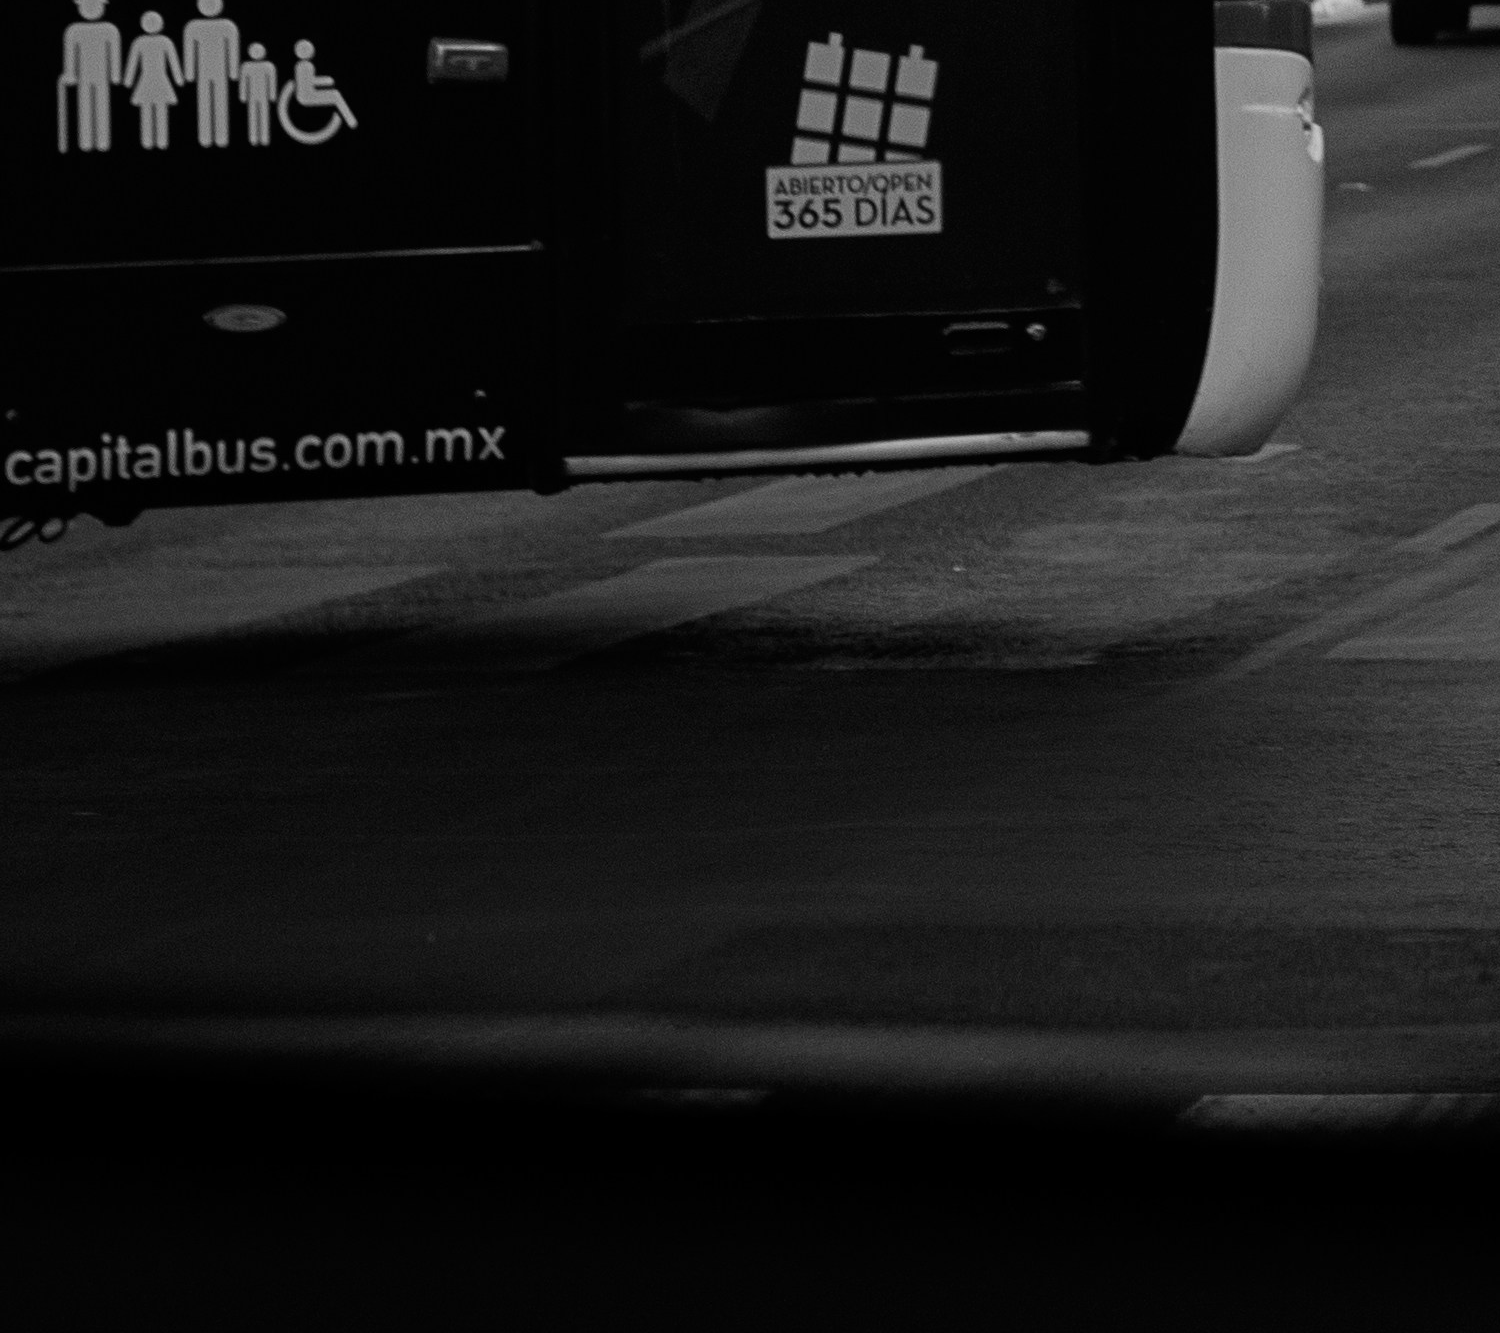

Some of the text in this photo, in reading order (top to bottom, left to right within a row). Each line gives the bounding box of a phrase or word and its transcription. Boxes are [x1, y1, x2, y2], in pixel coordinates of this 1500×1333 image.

[775, 172, 932, 196] ABIERTO/OPEN
[774, 198, 842, 229] 365
[3, 421, 508, 489] capitalbus.com.mx
